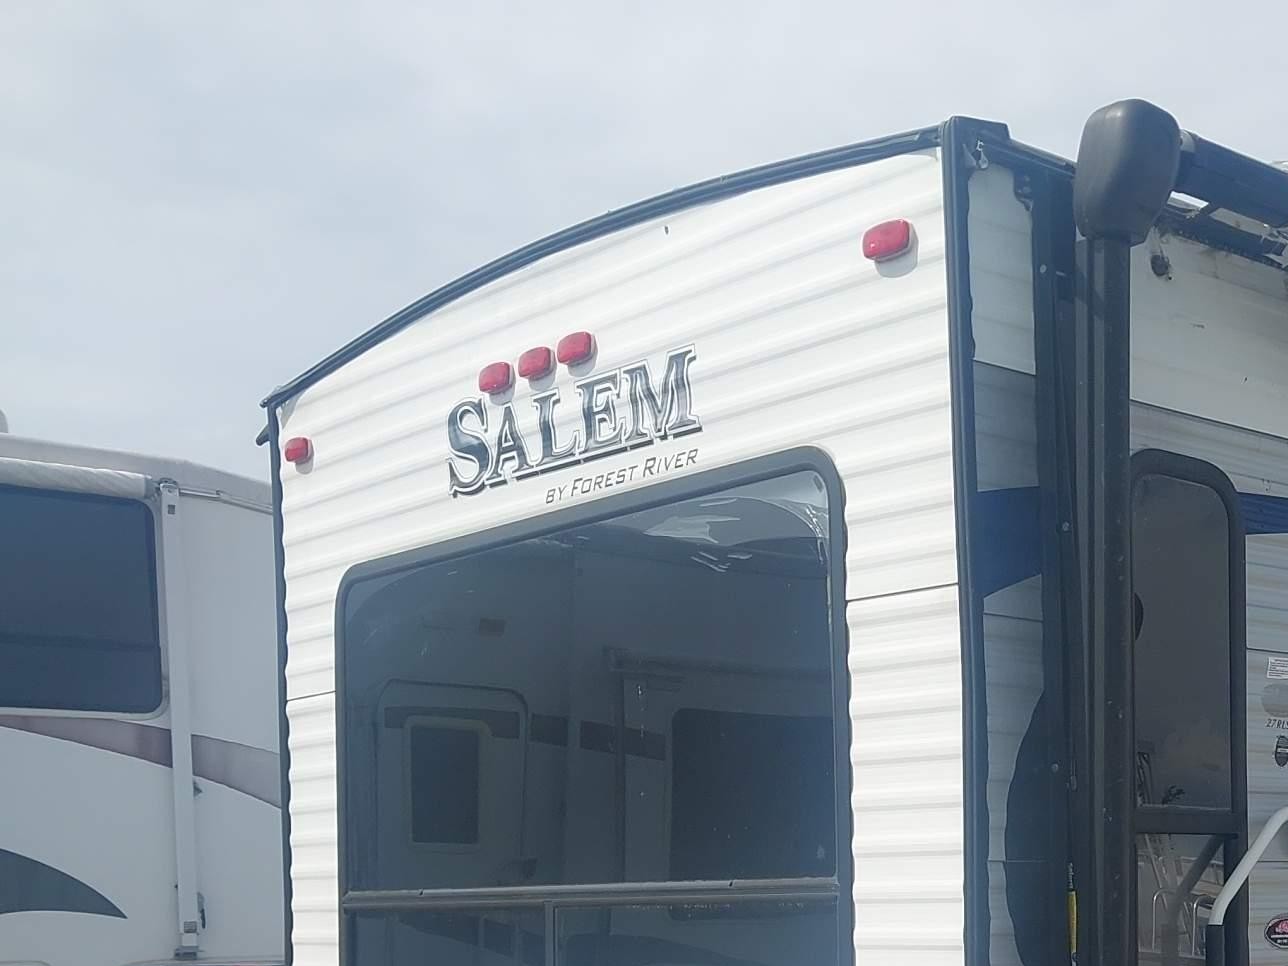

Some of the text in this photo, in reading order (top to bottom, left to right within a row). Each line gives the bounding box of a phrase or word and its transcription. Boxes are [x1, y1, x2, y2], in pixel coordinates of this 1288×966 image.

[446, 343, 704, 498] SALEM
[545, 447, 699, 504] BY FOREST RIVER
